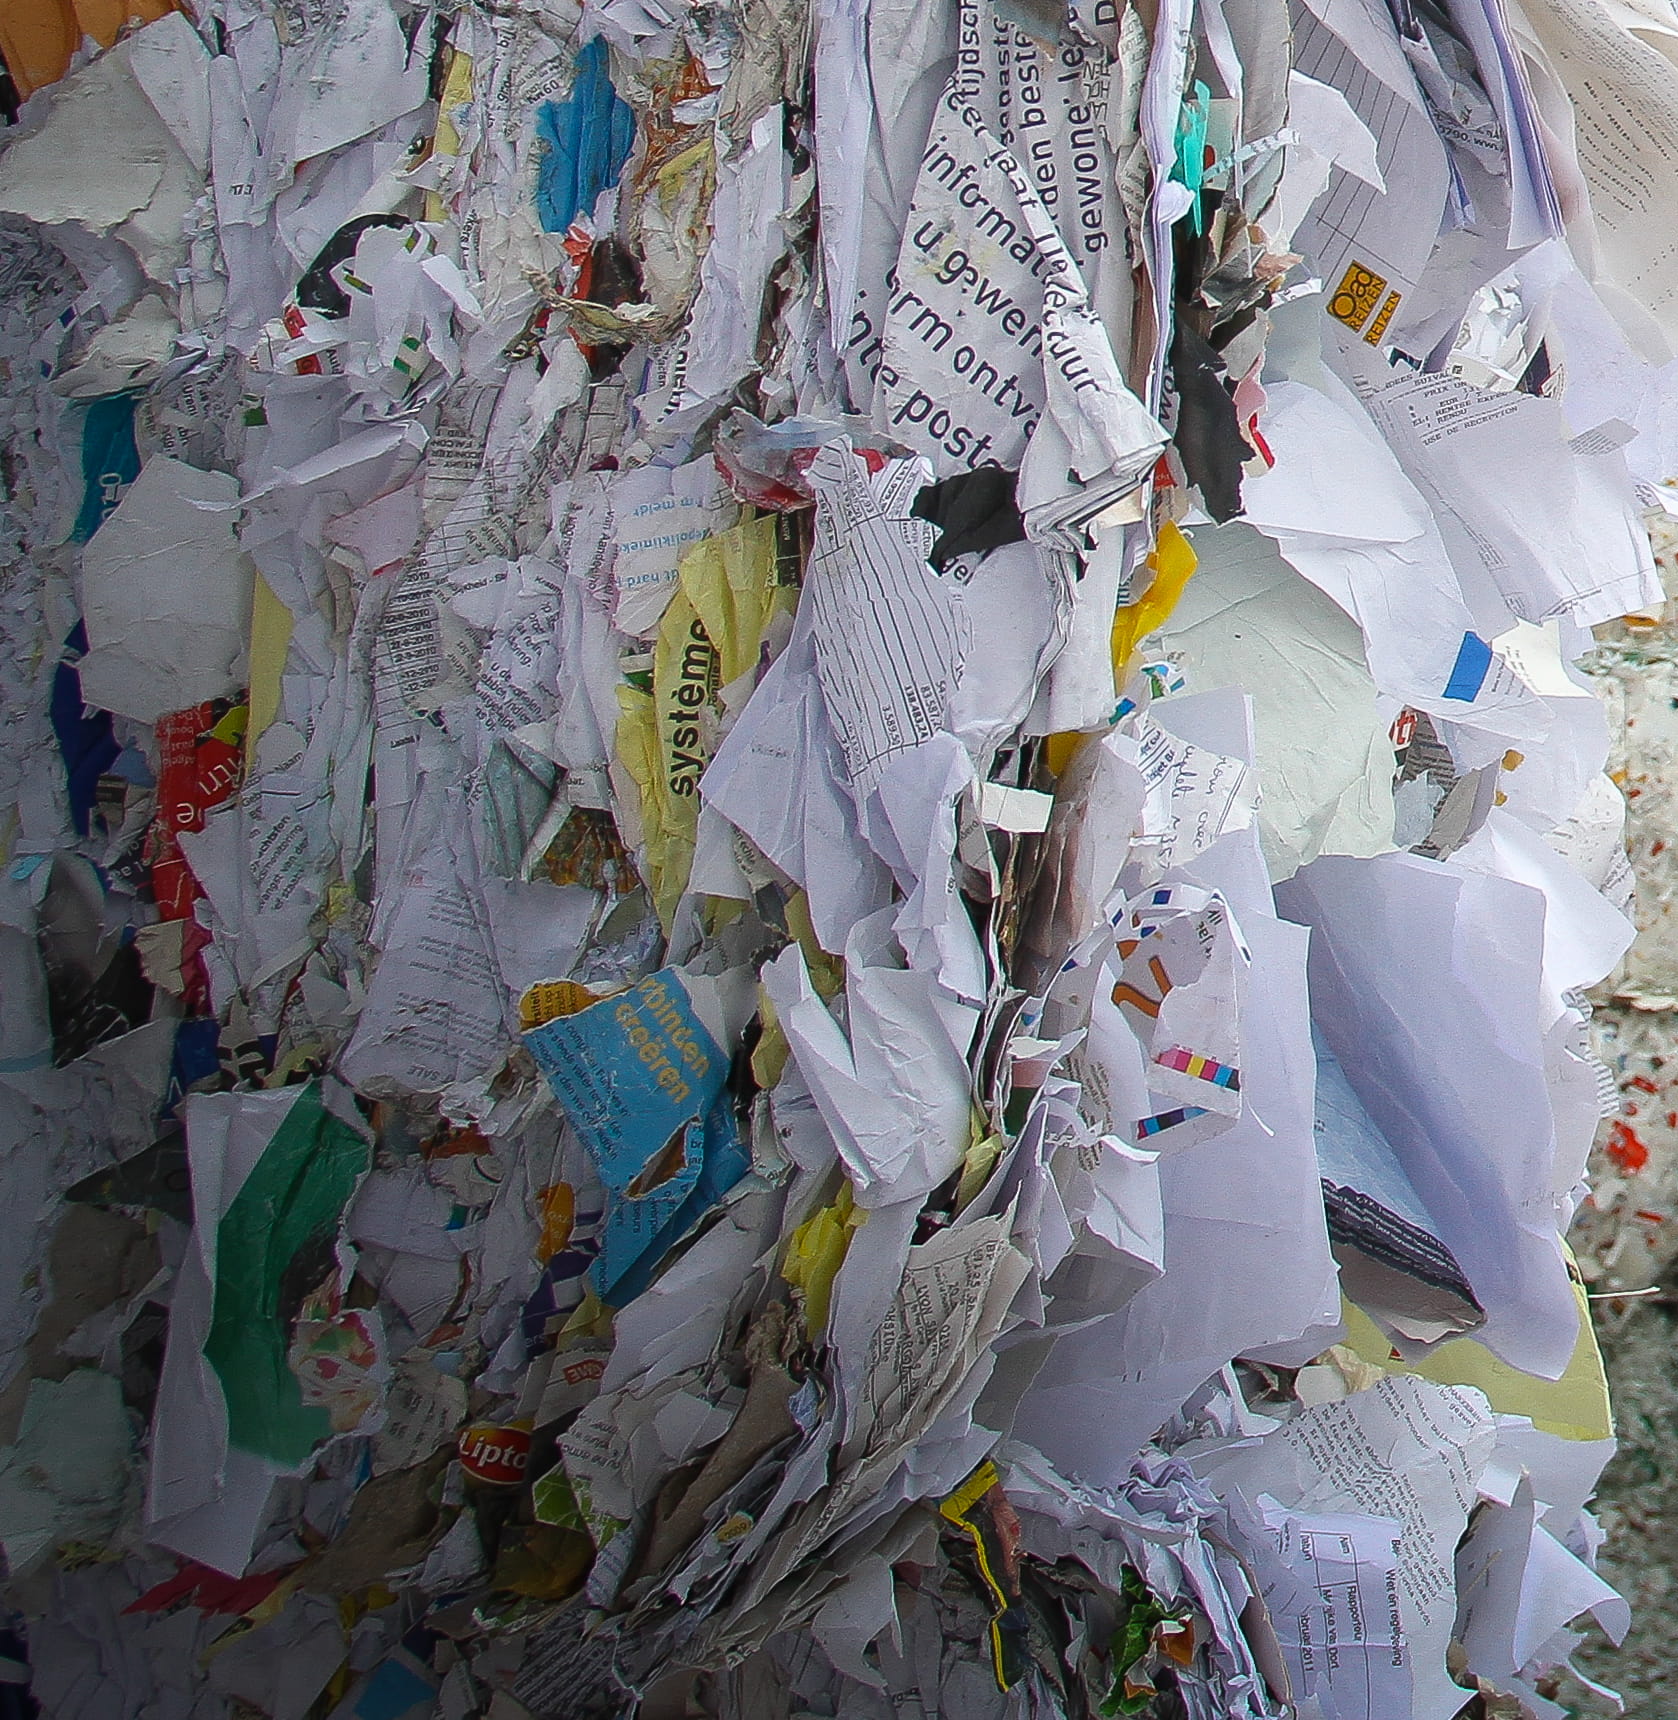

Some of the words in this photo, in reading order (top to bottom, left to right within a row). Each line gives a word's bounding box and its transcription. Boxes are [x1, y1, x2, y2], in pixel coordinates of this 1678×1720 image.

[912, 219, 946, 255] u
[1349, 279, 1384, 329] REIZEN
[1366, 293, 1400, 345] REIZEN
[1462, 406, 1520, 429] RECEPTION
